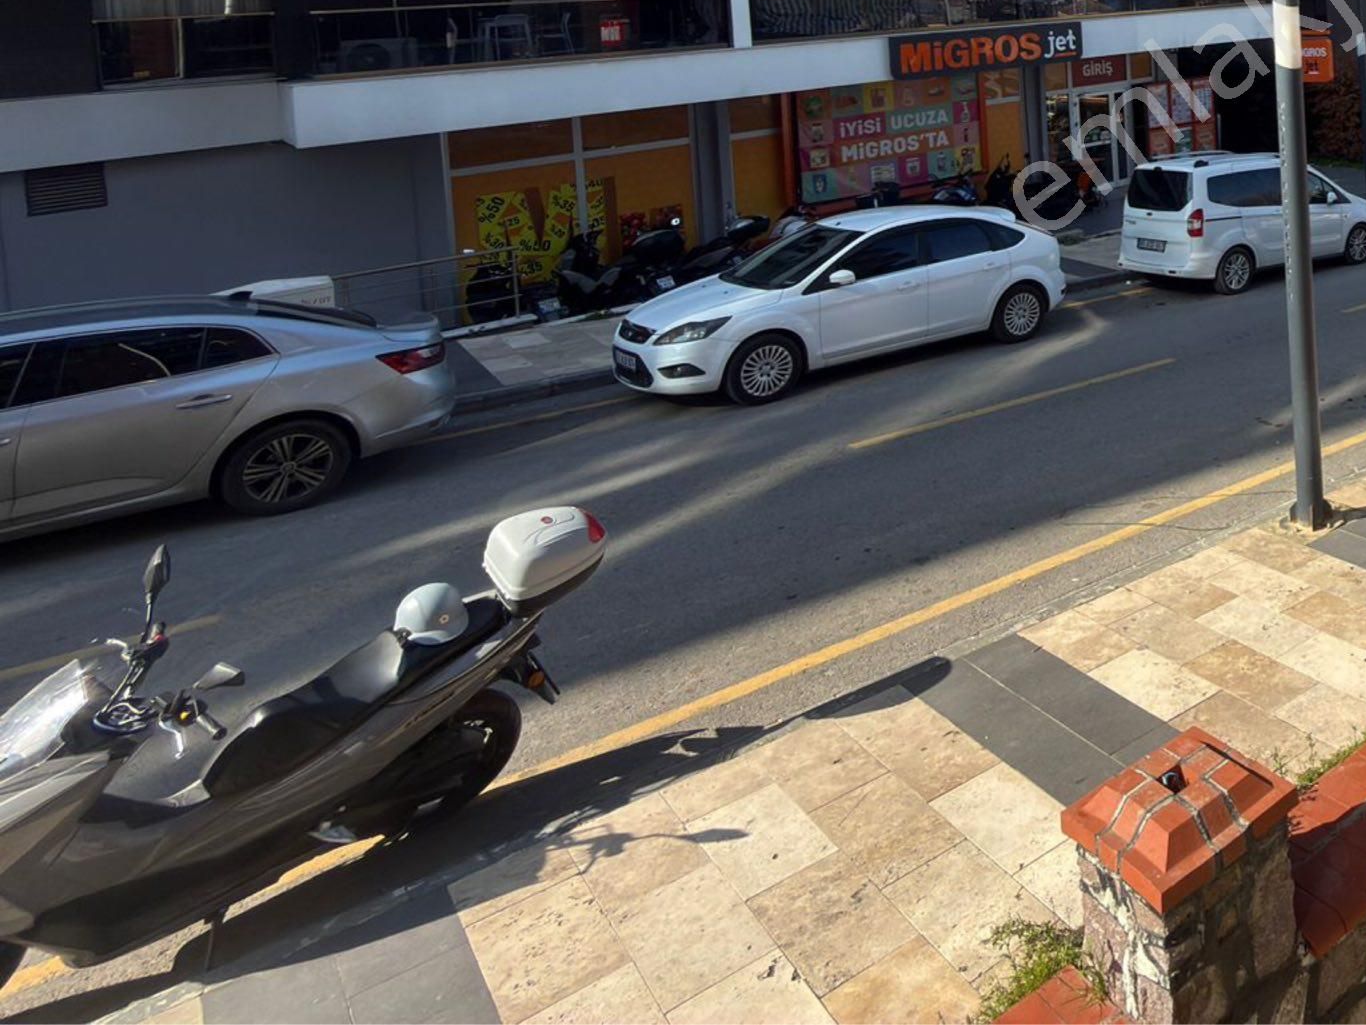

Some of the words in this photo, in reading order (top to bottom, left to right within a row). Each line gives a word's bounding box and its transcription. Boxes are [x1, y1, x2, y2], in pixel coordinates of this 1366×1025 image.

[1044, 29, 1077, 57] jet
[1302, 47, 1328, 57] GROS
[891, 109, 949, 129] UCUZA
[478, 196, 506, 224] %50
